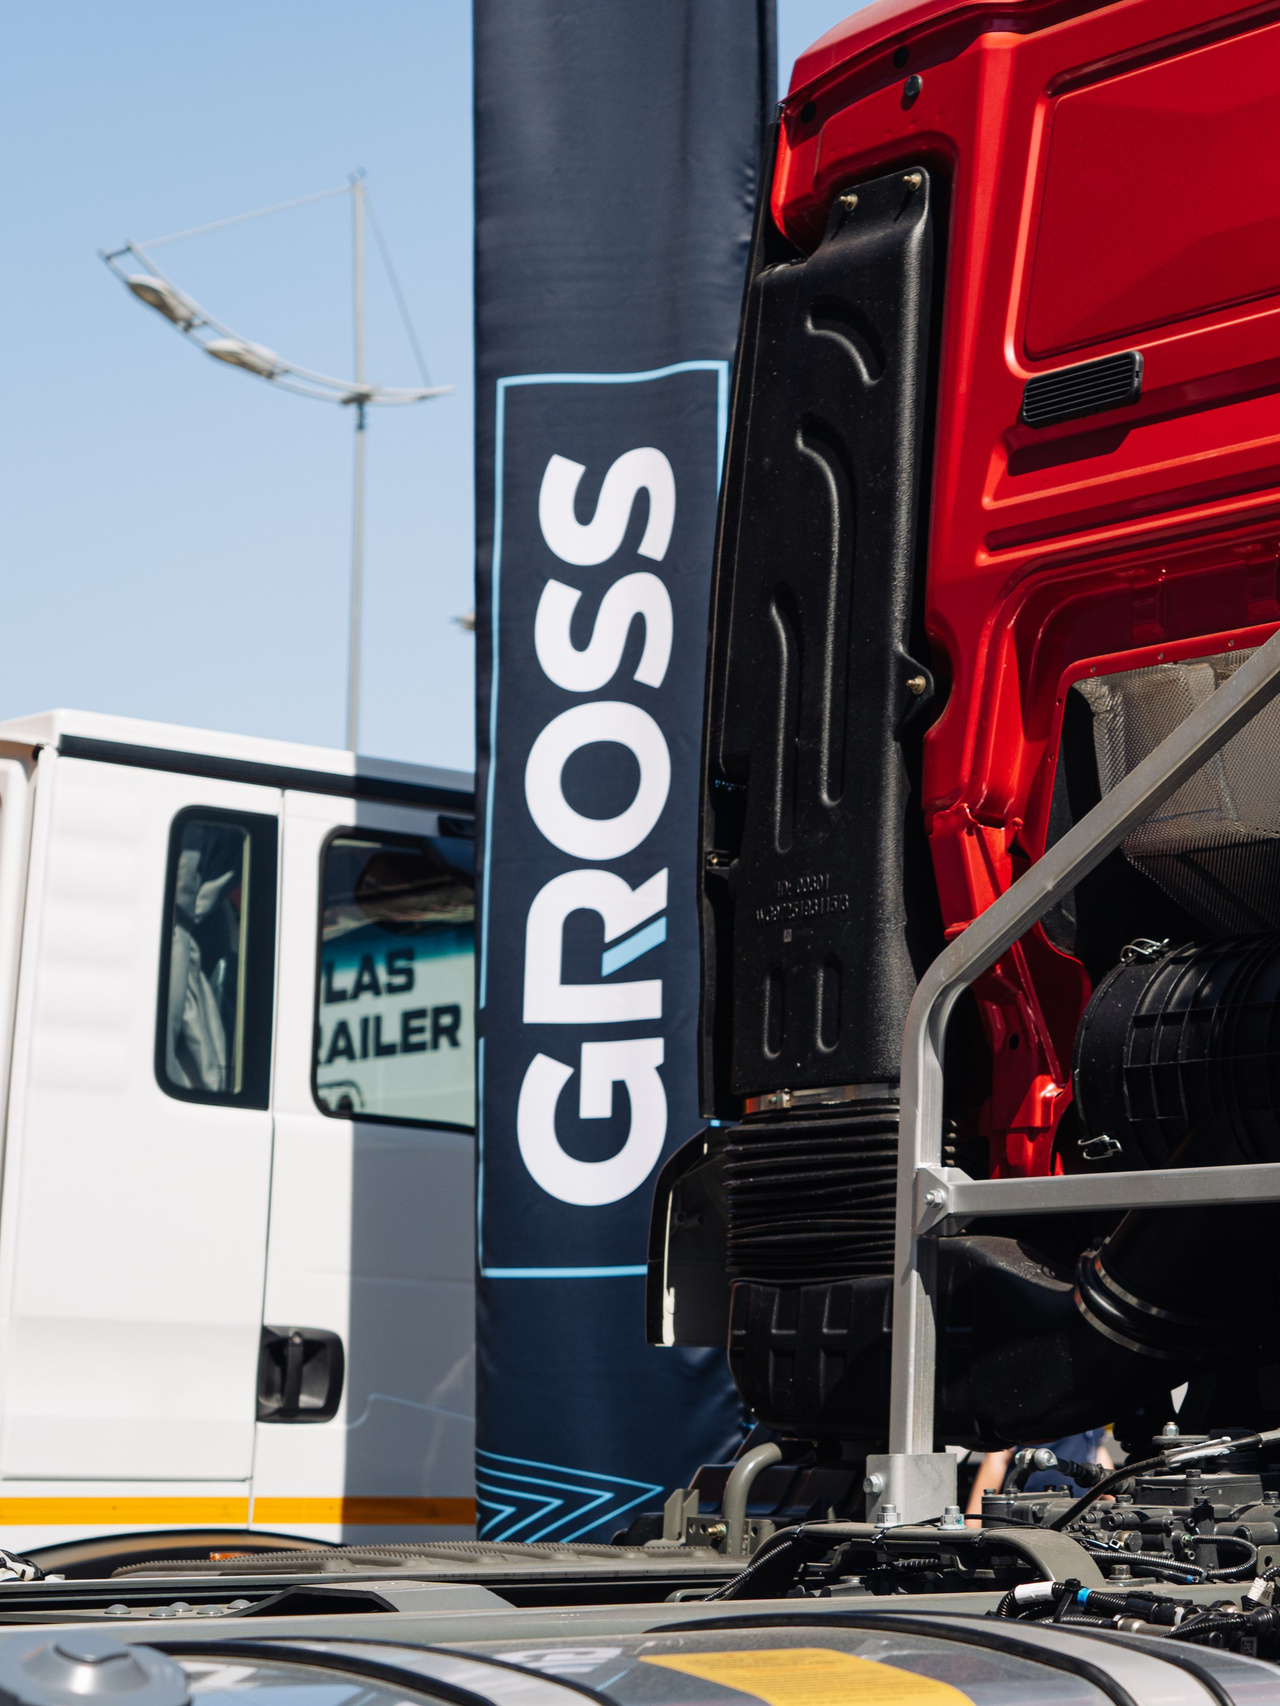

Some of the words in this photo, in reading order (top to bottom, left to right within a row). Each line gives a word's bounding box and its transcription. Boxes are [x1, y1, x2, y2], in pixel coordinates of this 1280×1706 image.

[518, 447, 675, 1206] GROSS
[323, 948, 415, 1006] LAS
[317, 1002, 462, 1066] AILER
